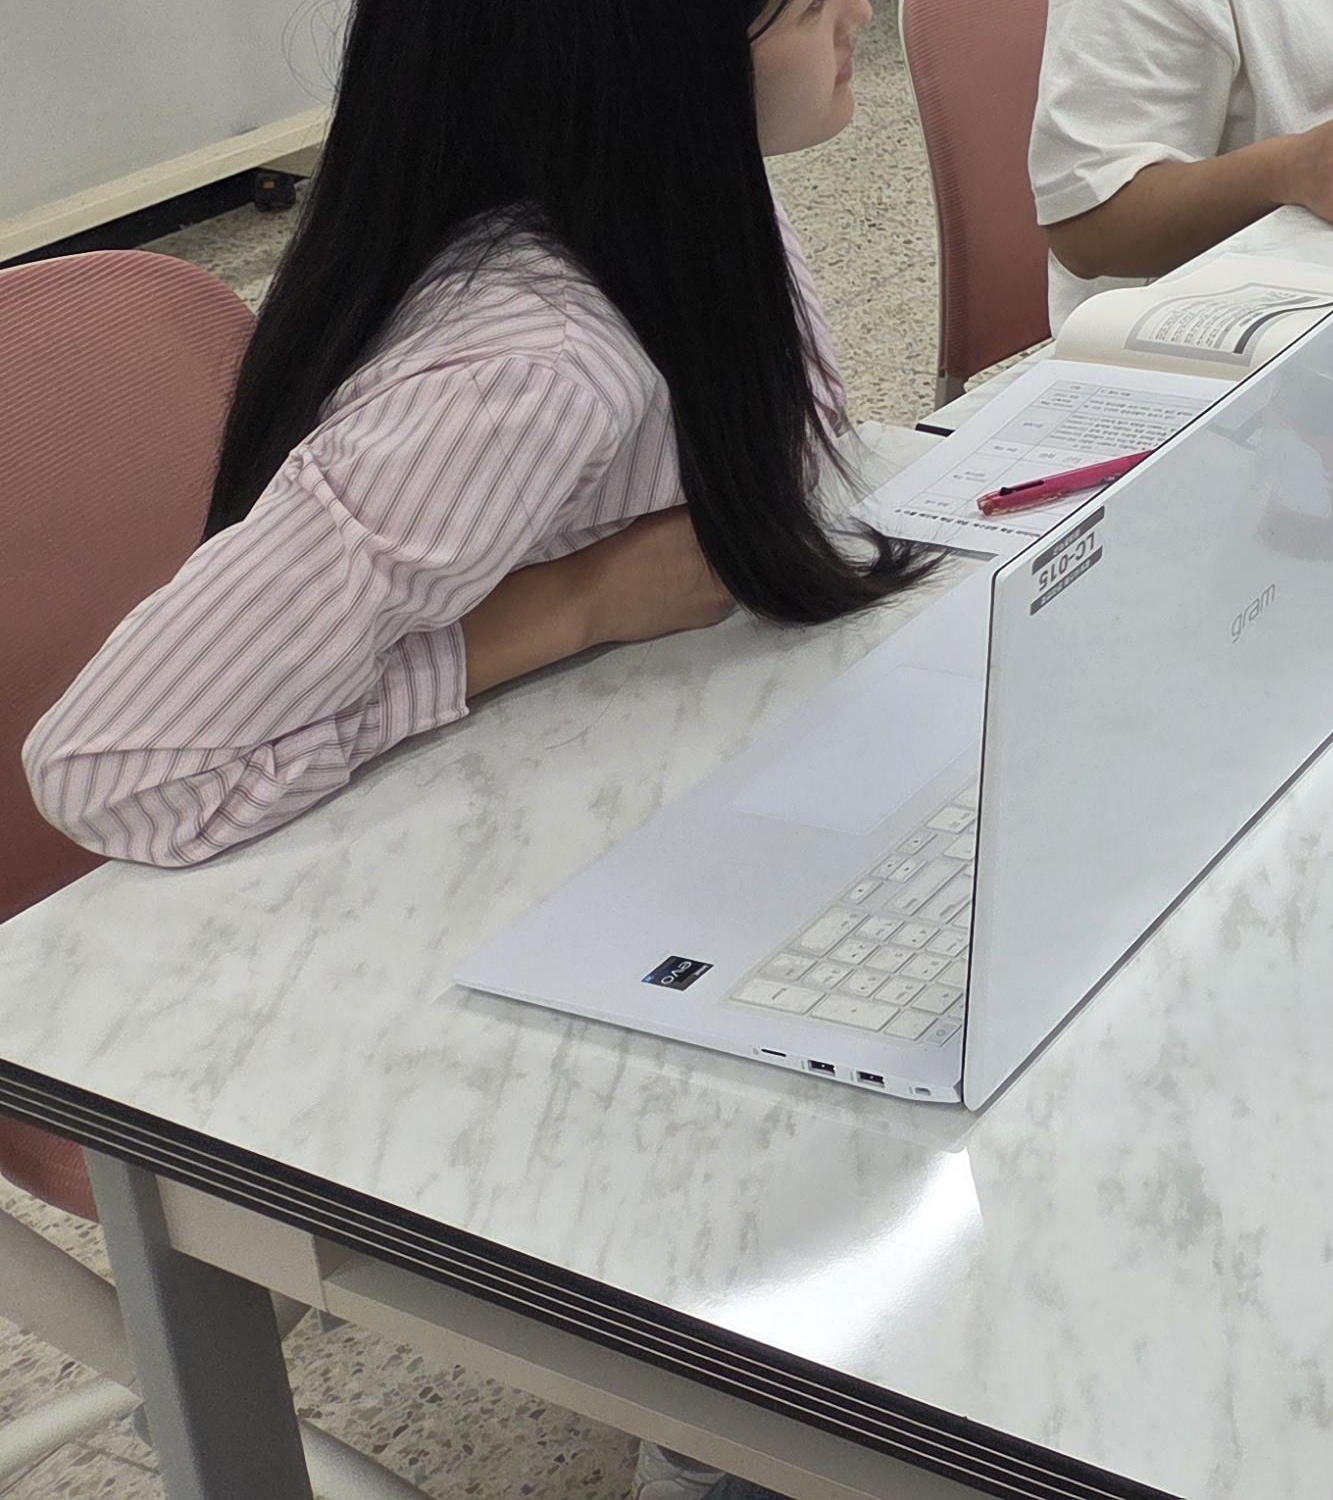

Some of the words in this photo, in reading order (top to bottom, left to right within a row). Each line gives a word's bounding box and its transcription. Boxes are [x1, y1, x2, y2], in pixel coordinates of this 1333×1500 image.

[1039, 531, 1095, 592] LC-015
[1231, 584, 1276, 644] gram
[660, 960, 692, 985] evo
